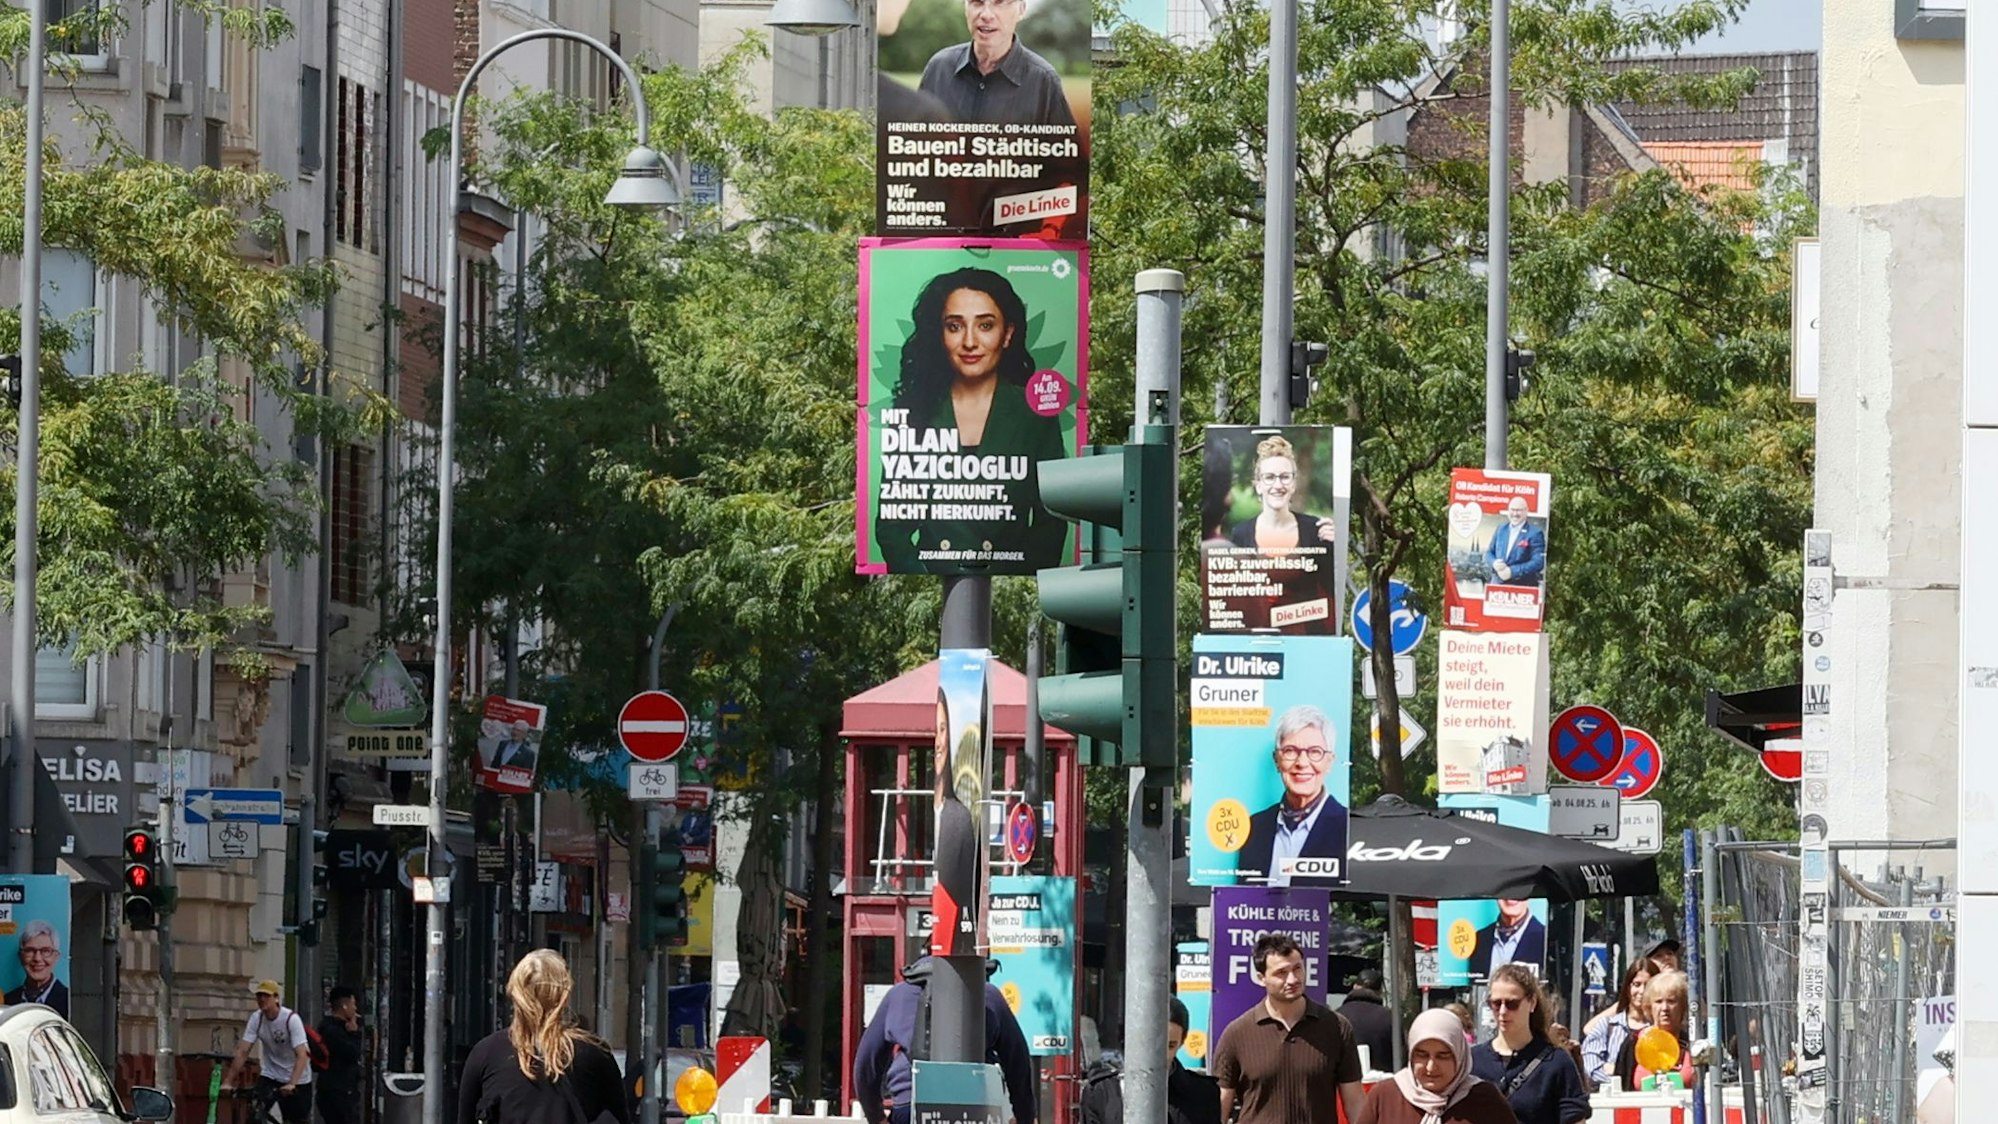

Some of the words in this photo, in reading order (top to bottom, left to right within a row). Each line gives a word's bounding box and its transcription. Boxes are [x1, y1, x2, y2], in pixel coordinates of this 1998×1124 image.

[888, 122, 926, 133] HEINER
[928, 123, 1003, 135] KOCKERBECK,
[1004, 124, 1077, 135] OB-KANDIDAT
[888, 136, 966, 155] Bauen!
[971, 136, 1078, 157] Städtisch
[887, 159, 929, 177] und
[934, 159, 1043, 178] bezahlbar
[887, 183, 917, 199] Wir
[887, 199, 945, 213] können
[1000, 203, 1025, 218] Die
[1029, 194, 1071, 213] Linke
[886, 212, 947, 226] anders.
[1033, 380, 1062, 395] 14.09.
[881, 408, 910, 424] MIT
[881, 455, 1028, 480] YAZICIOGLU
[880, 482, 930, 500] ZÄHLT
[932, 484, 1008, 503] ZUKUNFT,
[880, 503, 928, 520] NICHT
[931, 504, 1017, 521] HERKUNFT.
[918, 550, 961, 560] ZUSAMMEN
[961, 549, 977, 560] FÜR
[1208, 557, 1238, 570] KVB:
[1240, 557, 1318, 572] zuverlässig,
[1208, 570, 1270, 585] bezahlbar,
[1208, 583, 1283, 597] barrierefrei!
[1276, 609, 1294, 622] Die
[1295, 605, 1323, 618] Linke
[1447, 640, 1484, 654] Deine
[1488, 641, 1532, 656] Miete
[1198, 656, 1221, 675] Dr.
[1225, 655, 1280, 676] Ulrike
[1446, 660, 1488, 675] steigt,
[1444, 678, 1471, 691] weil
[1474, 679, 1505, 692] dein
[1199, 685, 1259, 701] Gruner
[1444, 696, 1512, 710] Vermieter
[1443, 715, 1461, 727] sie
[1465, 715, 1516, 729] erhöht.
[645, 786, 661, 796] frei
[380, 808, 423, 823] Piusstr.
[1219, 807, 1233, 818] 3x
[1216, 818, 1240, 832] CDU
[338, 843, 388, 875] sky
[1295, 861, 1336, 873] CDU
[1002, 898, 1015, 908] zur
[992, 914, 1009, 926] Nein
[1010, 917, 1020, 925] zu
[1228, 904, 1275, 920] KÜHLE
[1277, 906, 1311, 922] KÖPFE
[1311, 909, 1320, 922] &
[992, 932, 1062, 946] Verwahrlosung.
[1180, 954, 1193, 964] Dr.
[1420, 975, 1435, 983] frei
[1043, 1038, 1067, 1047] CDU
